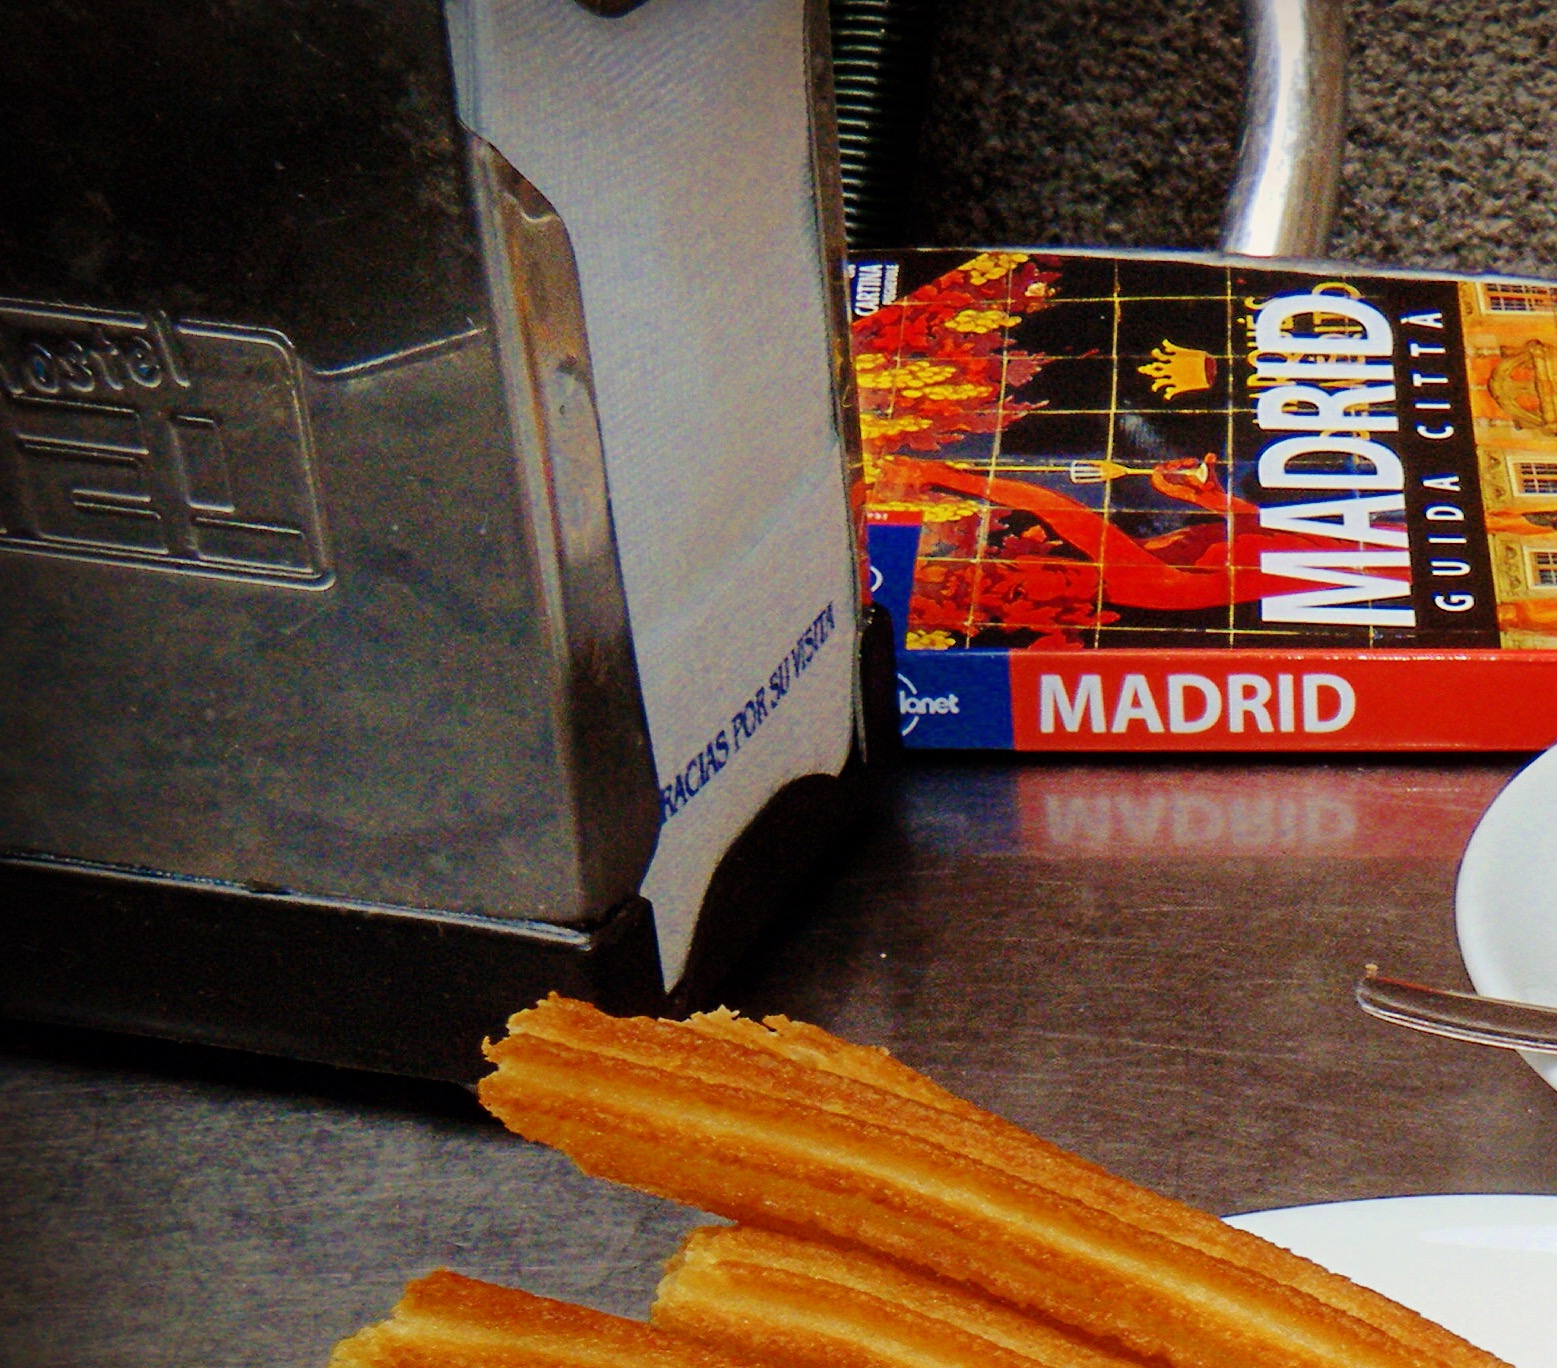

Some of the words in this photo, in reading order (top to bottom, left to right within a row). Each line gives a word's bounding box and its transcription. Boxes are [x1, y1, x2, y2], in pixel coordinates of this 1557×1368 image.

[1256, 292, 1416, 627] MADRID
[1422, 472, 1475, 613] GUIDA
[658, 729, 729, 824] RACIAS
[731, 686, 769, 752] POR
[899, 691, 960, 714] lanet
[1039, 673, 1357, 734] MADRID
